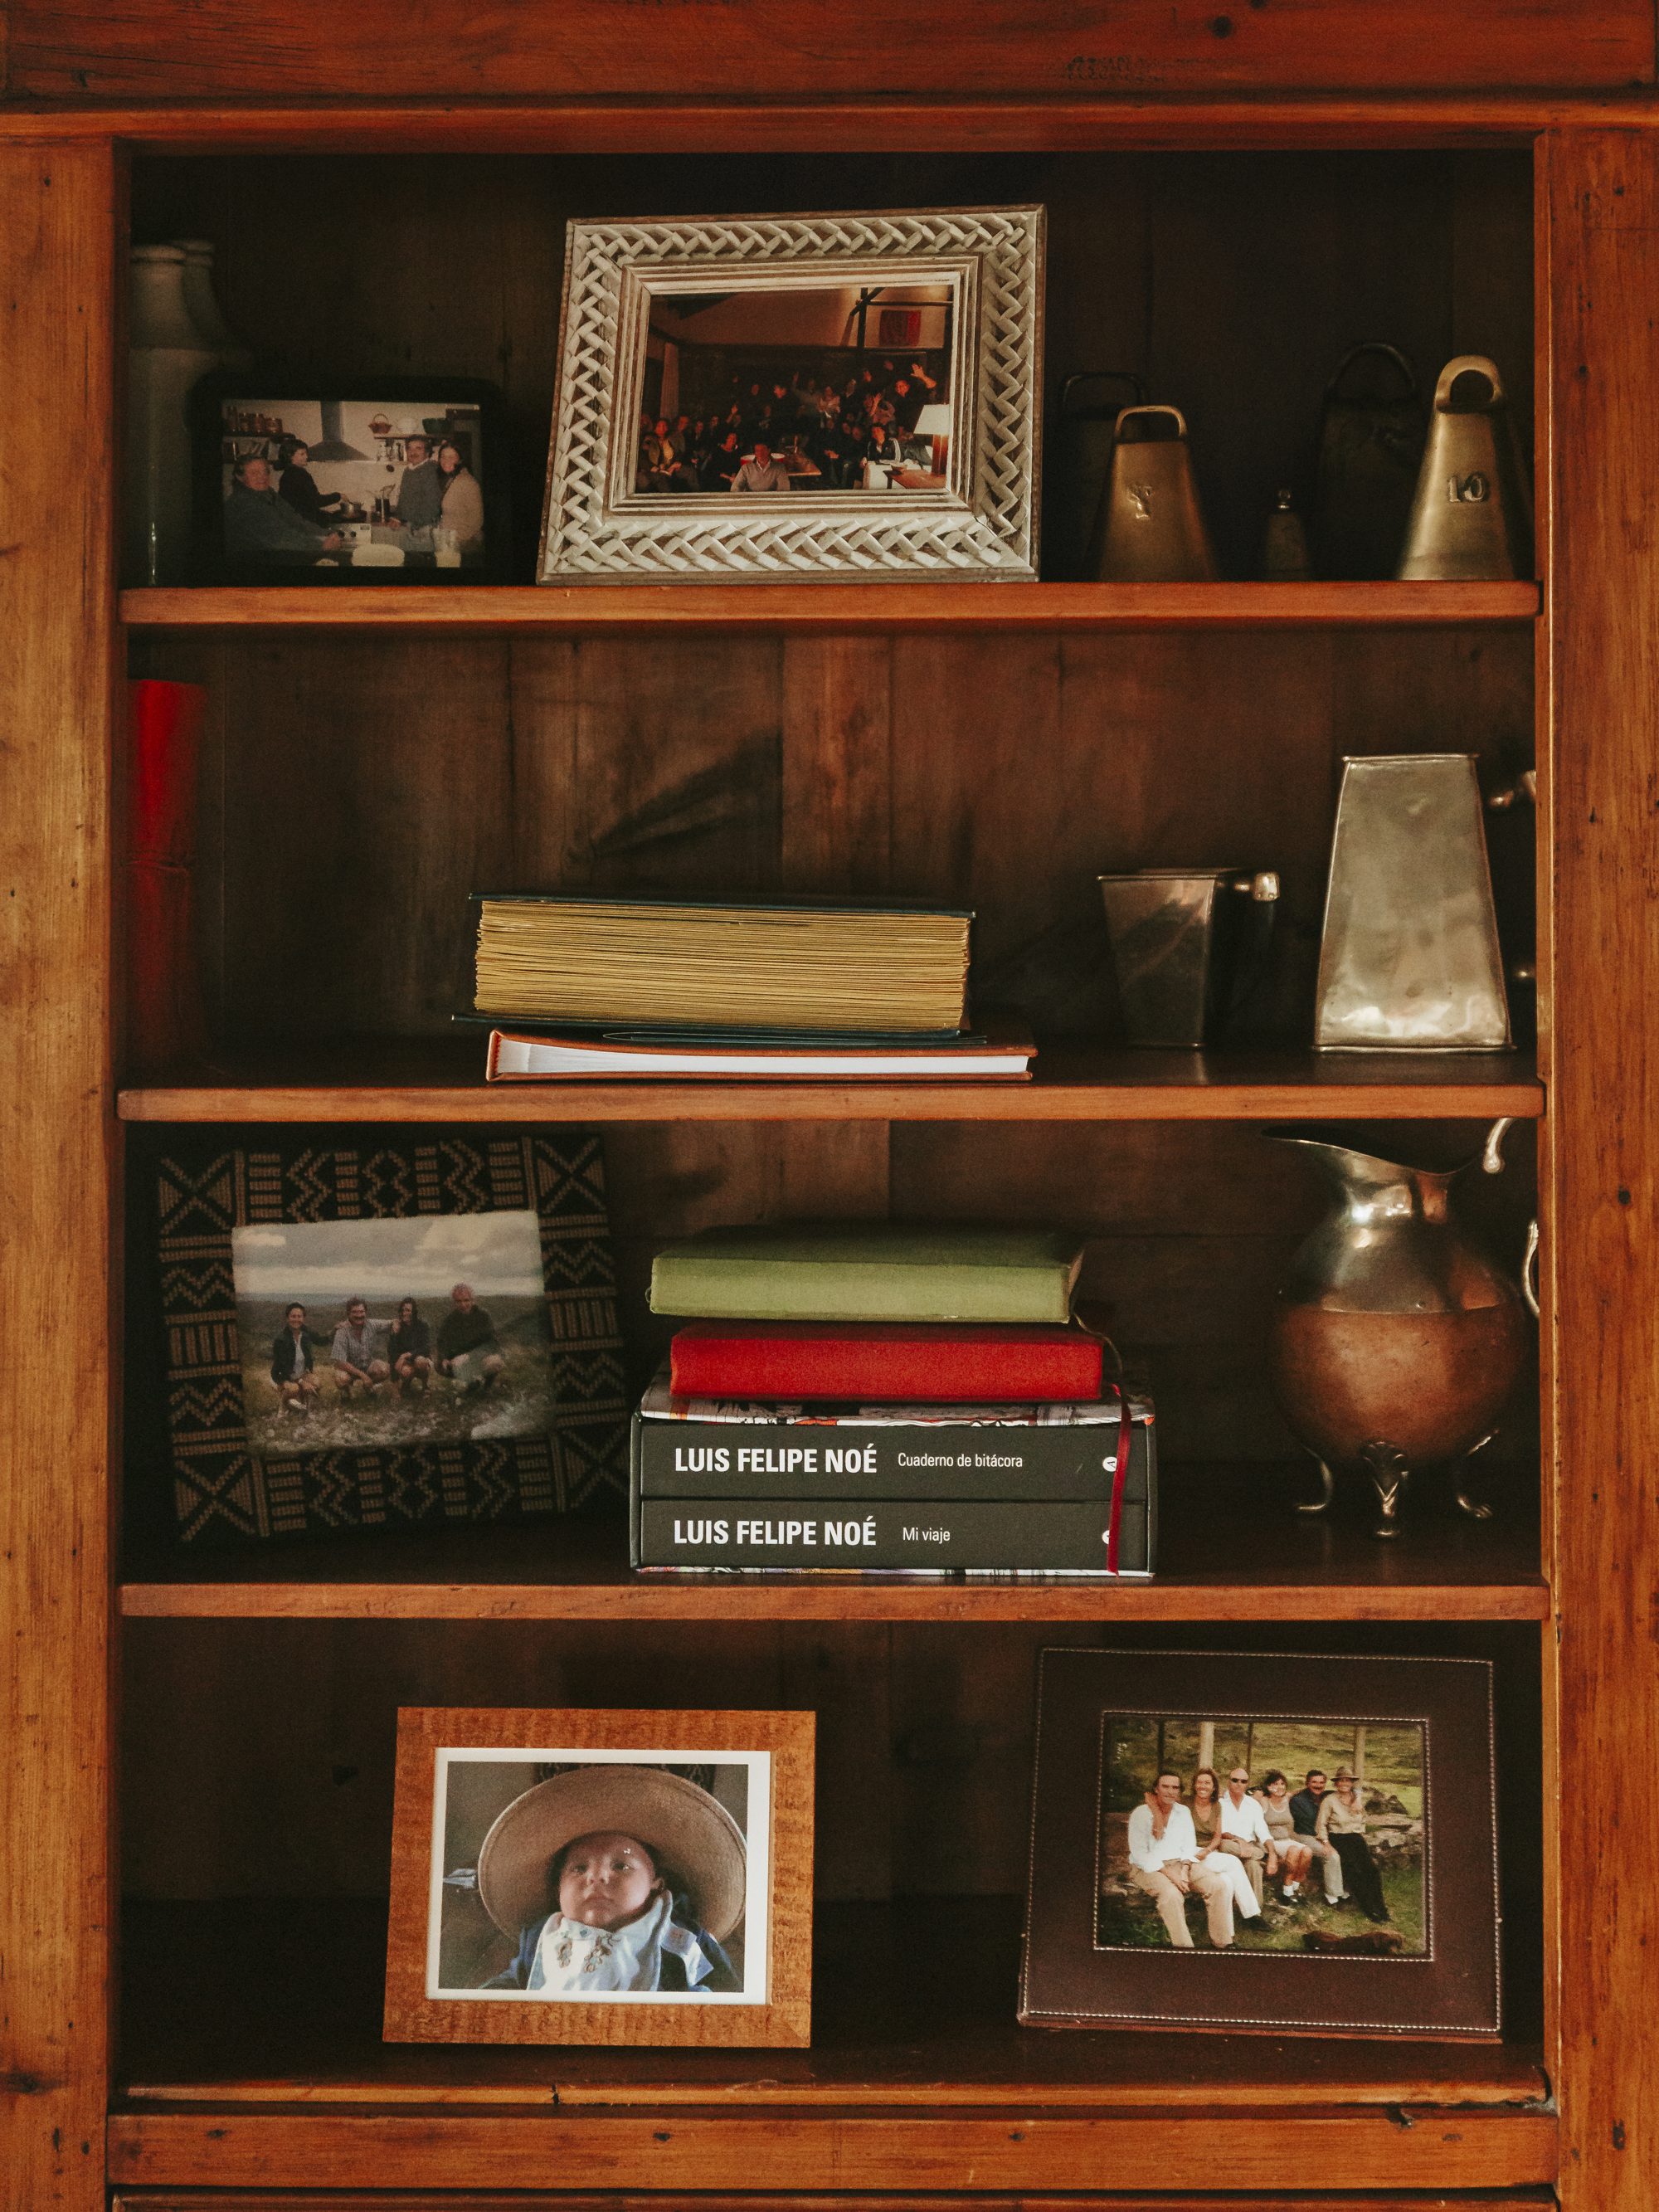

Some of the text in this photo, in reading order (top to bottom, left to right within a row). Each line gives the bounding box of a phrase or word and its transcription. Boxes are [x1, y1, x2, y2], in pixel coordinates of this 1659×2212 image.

[1447, 471, 1490, 503] 10
[674, 1442, 878, 1474] LUIS FELIPE NOÉ
[897, 1452, 1024, 1468] Cuaderno de bitácora
[674, 1515, 877, 1546] LUIS FELIPE NOÉ
[902, 1527, 951, 1545] Mi viaje
